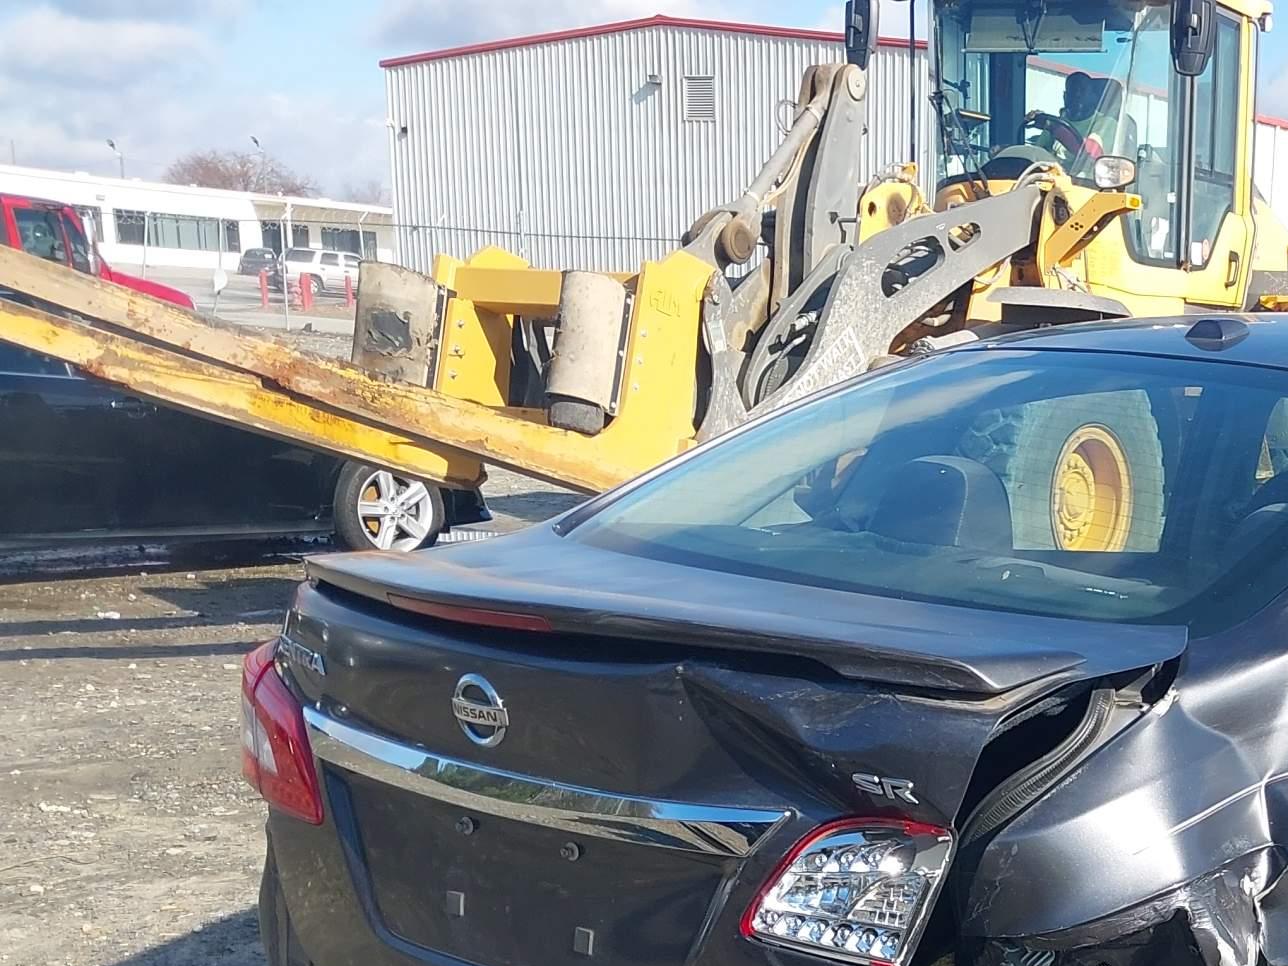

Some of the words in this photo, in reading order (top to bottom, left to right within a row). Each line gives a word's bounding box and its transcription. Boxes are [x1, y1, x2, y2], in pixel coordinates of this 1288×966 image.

[818, 333, 855, 370] WALK
[454, 702, 498, 723] NISSAN
[851, 773, 919, 805] SR
